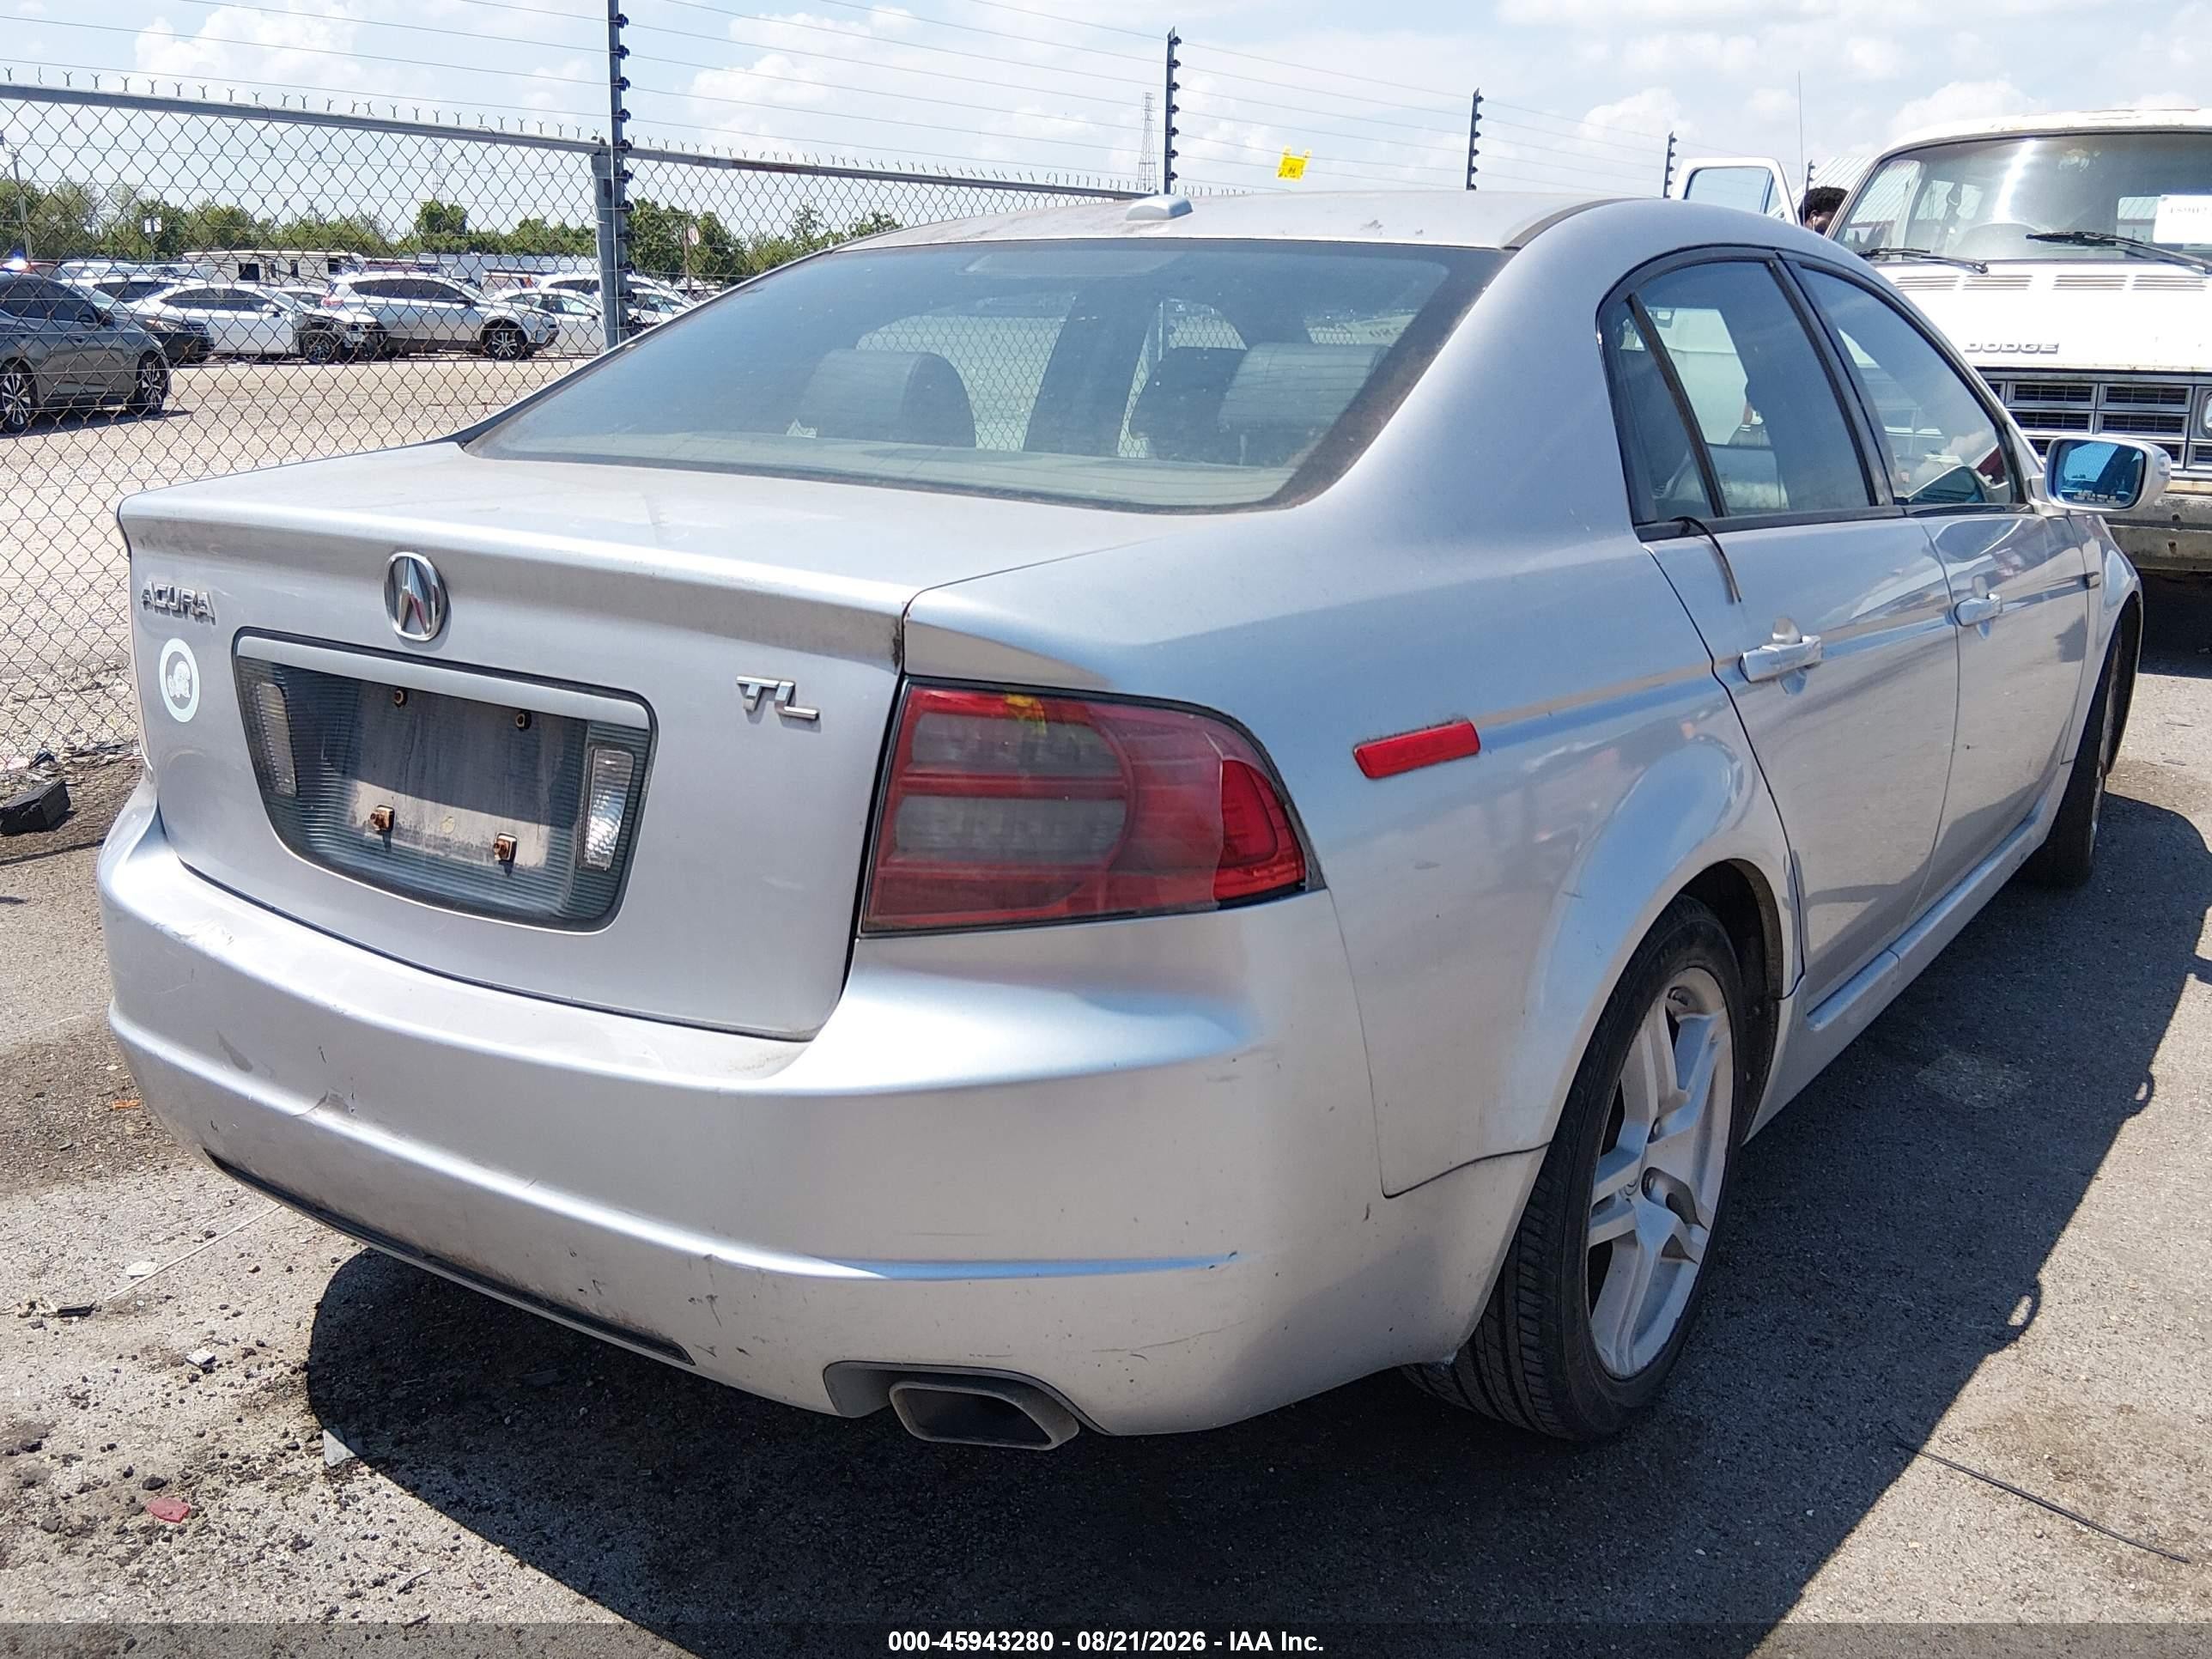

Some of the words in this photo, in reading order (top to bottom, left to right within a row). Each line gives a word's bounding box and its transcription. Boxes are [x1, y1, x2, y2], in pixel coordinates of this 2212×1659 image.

[1964, 340, 2059, 354] DODGE
[141, 581, 216, 622] ACURA
[736, 676, 819, 720] TL
